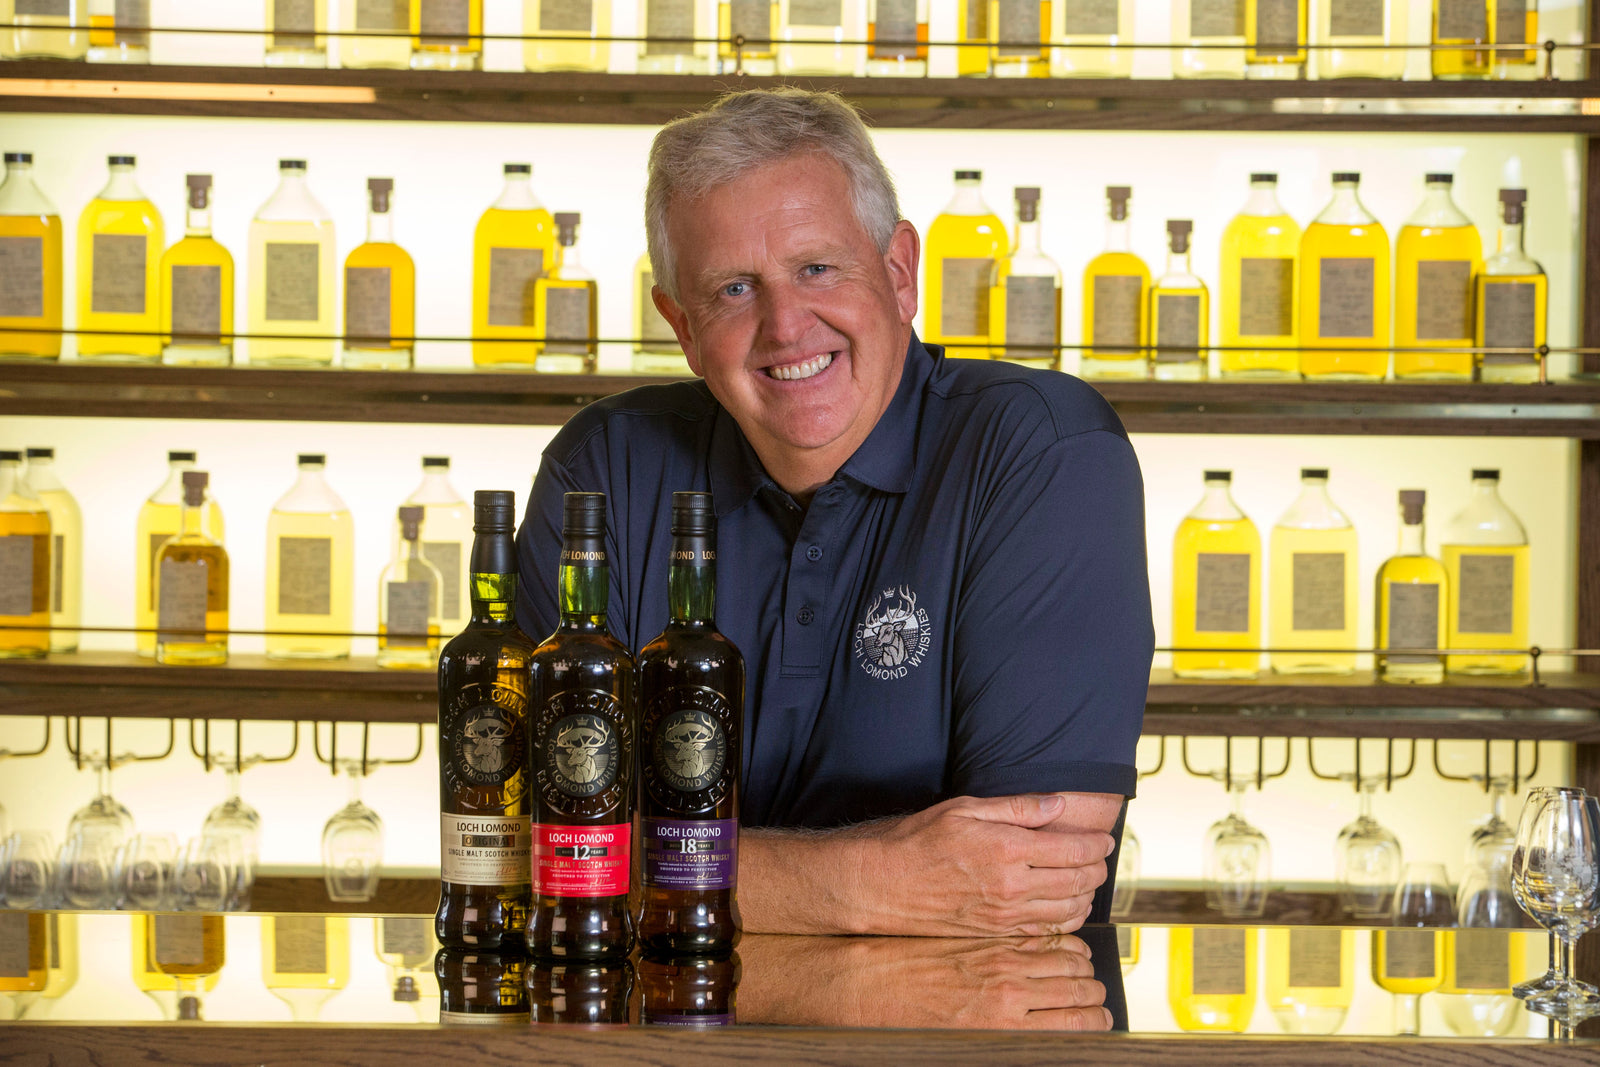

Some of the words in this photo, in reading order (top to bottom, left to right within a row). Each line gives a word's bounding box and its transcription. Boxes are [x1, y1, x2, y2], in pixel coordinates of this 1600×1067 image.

[571, 550, 606, 560] LOMOND
[854, 622, 865, 658] LOCH
[861, 658, 908, 680] LOMOND
[908, 608, 932, 668] WHISKIES
[703, 733, 724, 782] WHISKIES
[459, 759, 501, 783] LOMOND
[547, 738, 557, 767] LOCH
[552, 768, 595, 793] LOMOND
[596, 738, 617, 788] WHISKIES
[457, 822, 479, 832] LOCH
[481, 823, 521, 832] LOMOND
[657, 827, 680, 837] LOCH
[682, 827, 721, 837] LOMOND
[549, 832, 572, 843] LOCH
[574, 833, 614, 844] LOMOND
[572, 844, 591, 860] 12
[680, 838, 697, 854] 18
[448, 848, 464, 856] SINGLE
[466, 850, 482, 858] MALT
[484, 850, 509, 858] SCOTCH
[666, 854, 683, 862] MALT
[686, 854, 710, 862] SCOTCH
[711, 854, 730, 862] WHISKY
[604, 860, 623, 868] WHISKY
